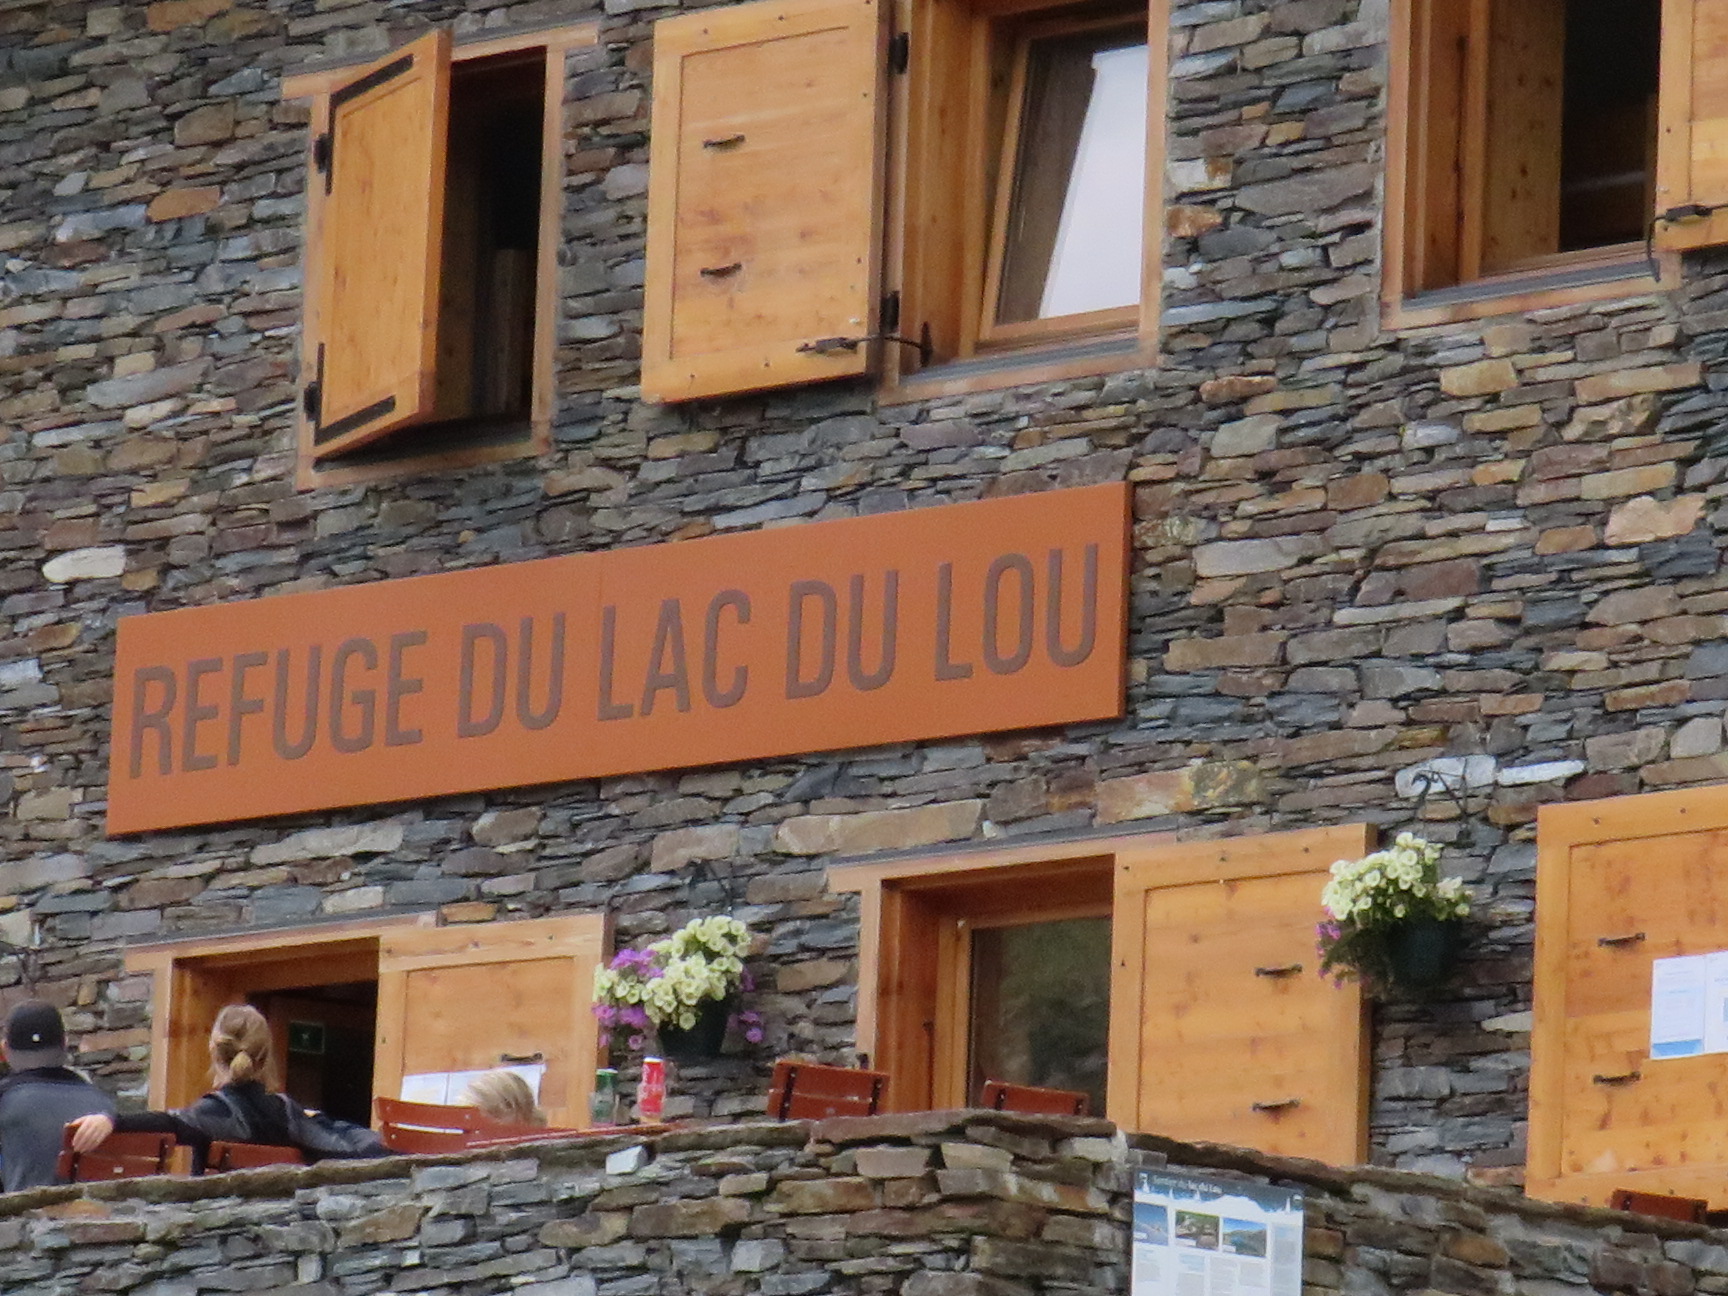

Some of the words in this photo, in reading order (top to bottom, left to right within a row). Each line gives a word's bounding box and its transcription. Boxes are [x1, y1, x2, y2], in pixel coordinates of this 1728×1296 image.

[129, 630, 428, 779] REFUGE
[457, 611, 566, 739] DU
[597, 588, 752, 722] LAC
[784, 569, 900, 701] DU
[934, 542, 1098, 683] LOU
